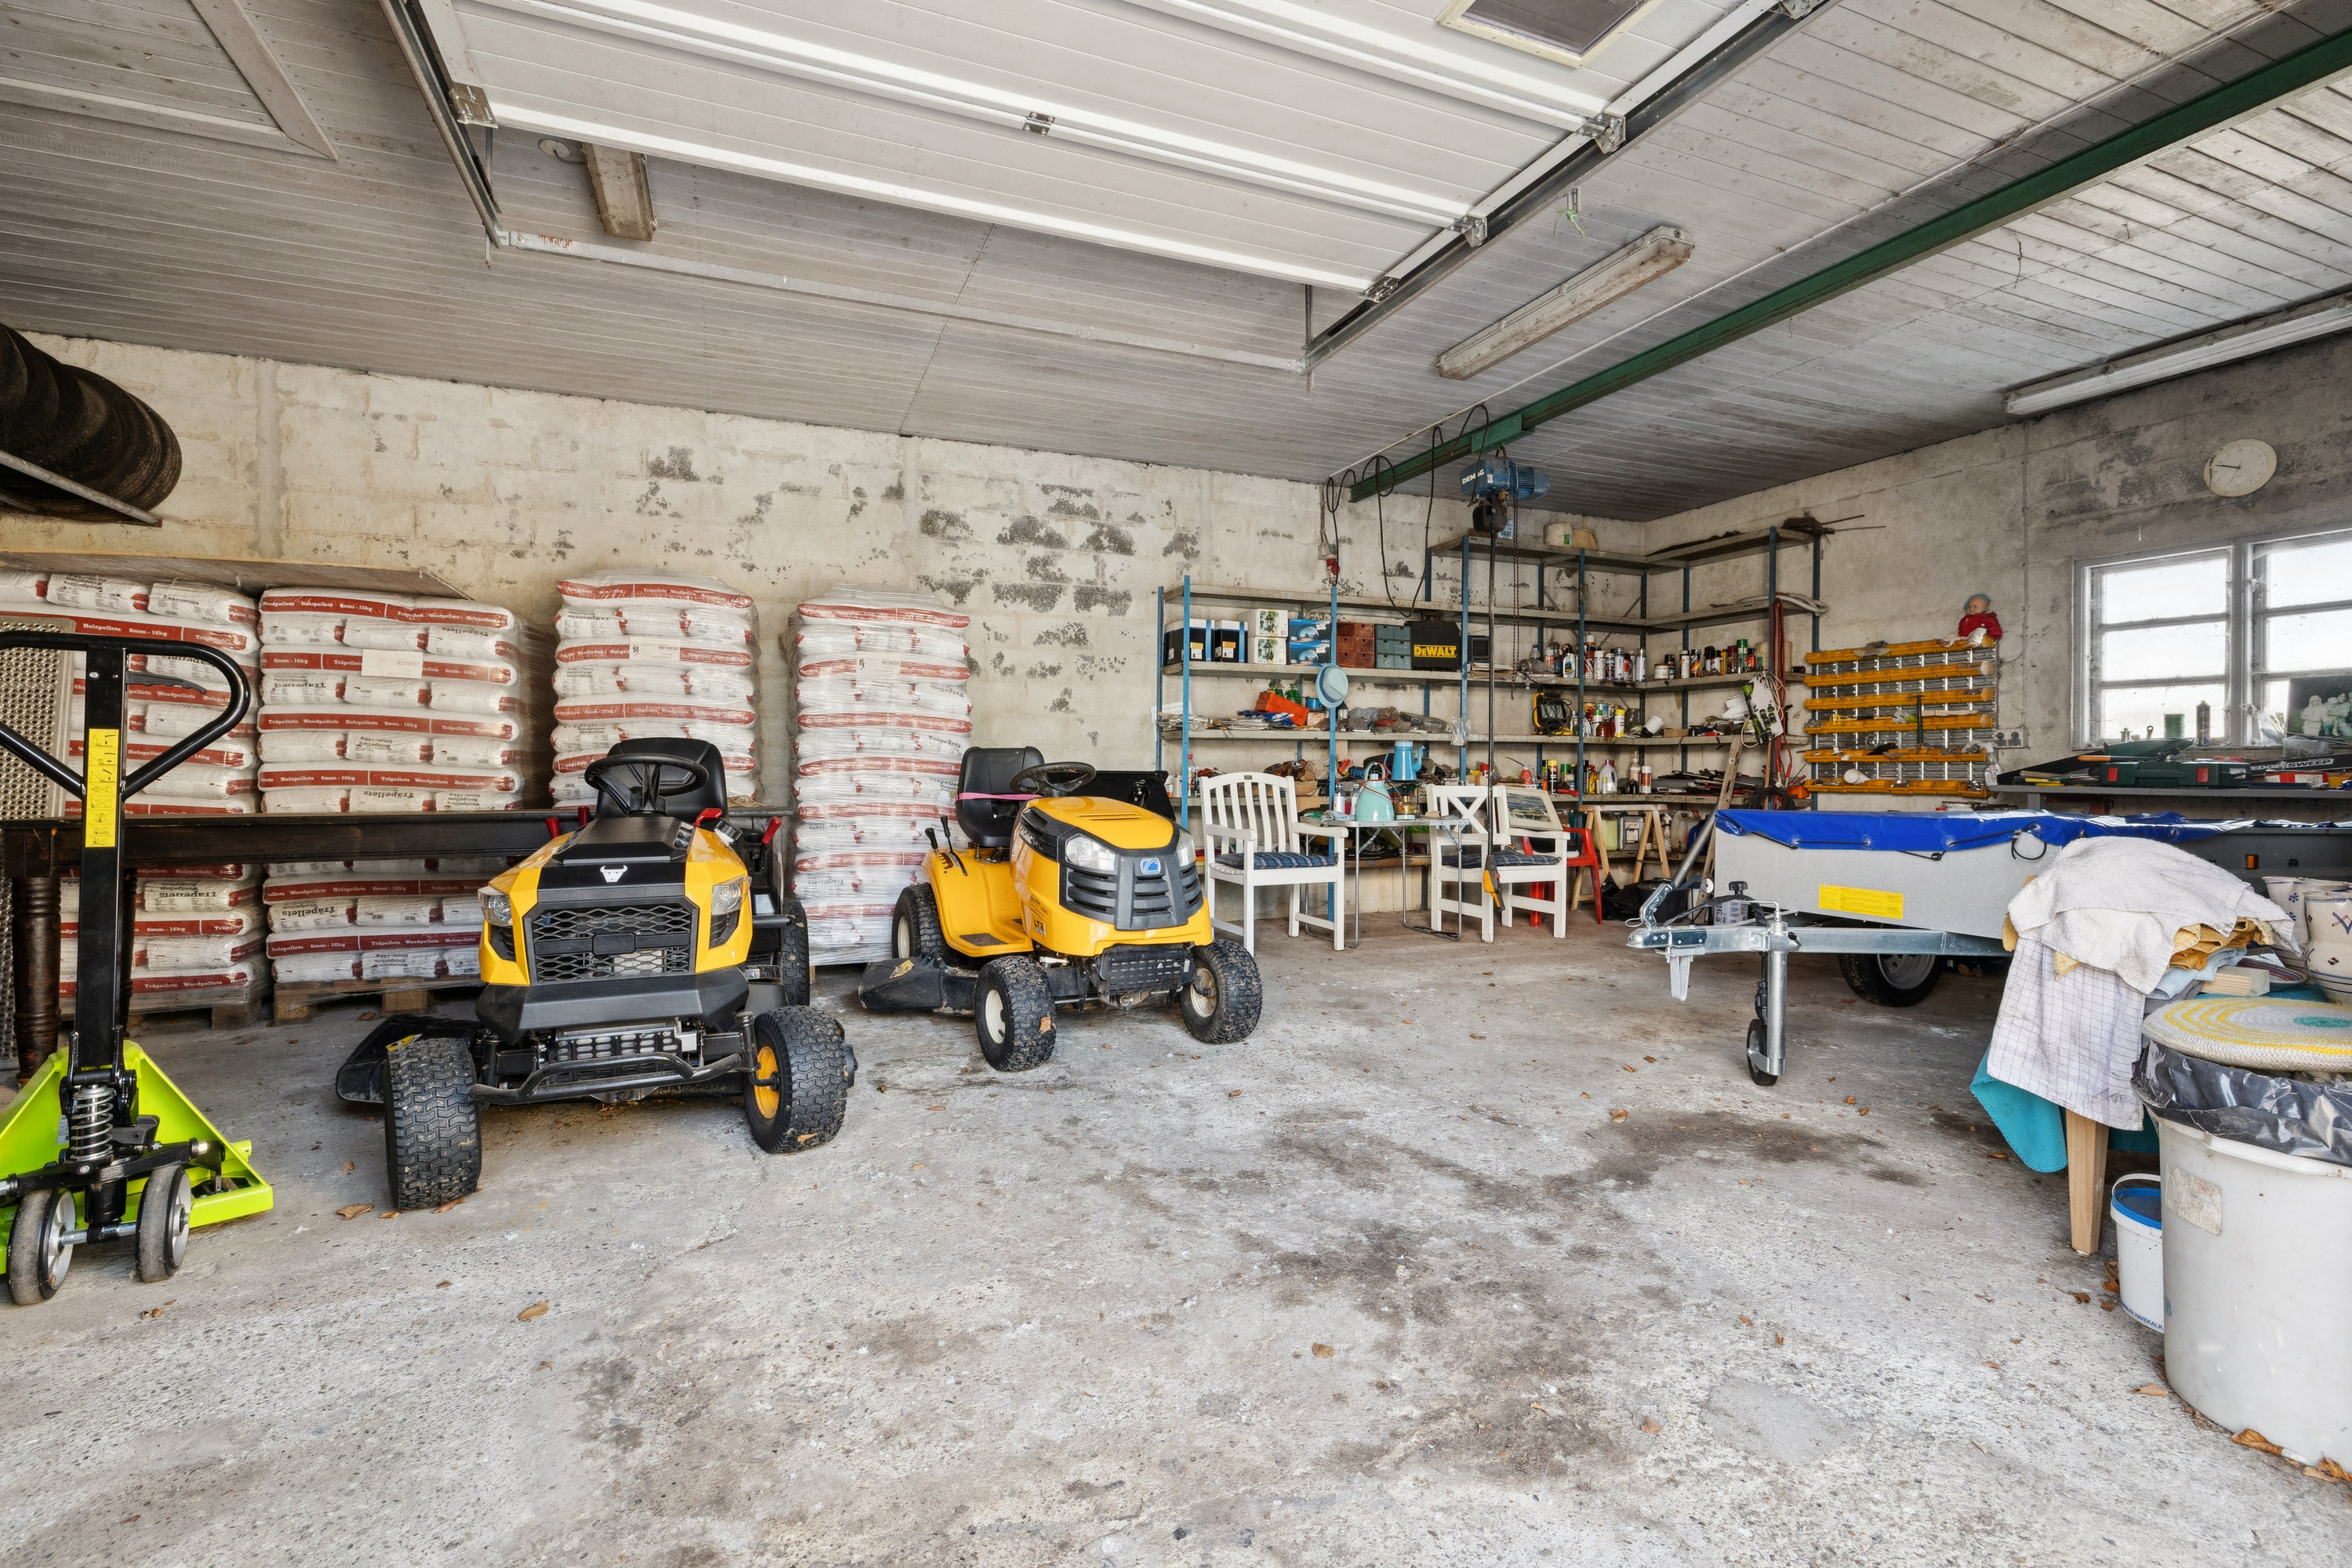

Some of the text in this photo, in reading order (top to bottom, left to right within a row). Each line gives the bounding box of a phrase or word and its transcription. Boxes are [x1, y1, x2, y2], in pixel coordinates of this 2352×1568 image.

[83, 623, 122, 632] Holzpellets
[156, 691, 196, 699] Woodpellets
[2287, 759, 2333, 768] SWEEP
[363, 790, 415, 799] Träpellets
[282, 906, 335, 917] Träpellets
